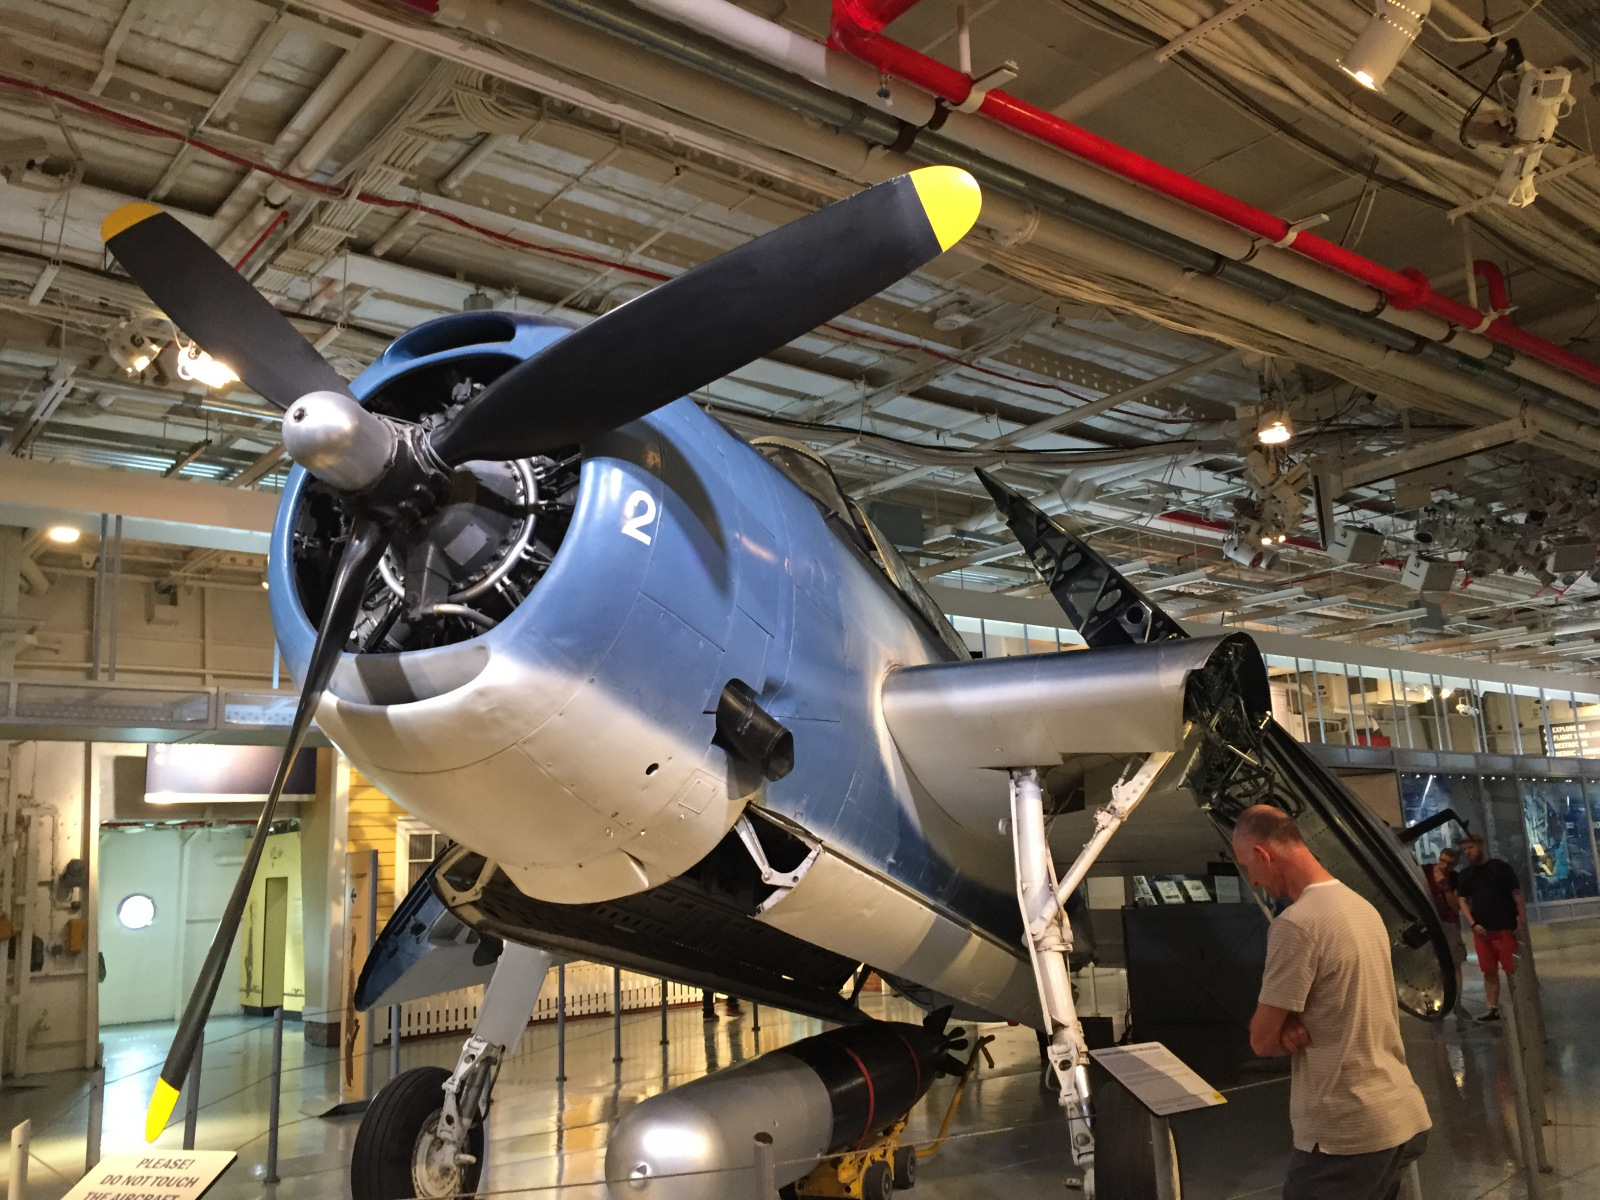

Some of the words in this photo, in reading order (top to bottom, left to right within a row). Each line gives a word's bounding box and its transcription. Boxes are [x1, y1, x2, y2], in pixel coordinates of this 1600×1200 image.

[621, 490, 656, 546] 2
[136, 1158, 196, 1170] PLEASE!
[100, 1174, 123, 1185] DO
[121, 1175, 151, 1187] NOT
[149, 1176, 200, 1188] TOUCH
[83, 1191, 111, 1200] THE
